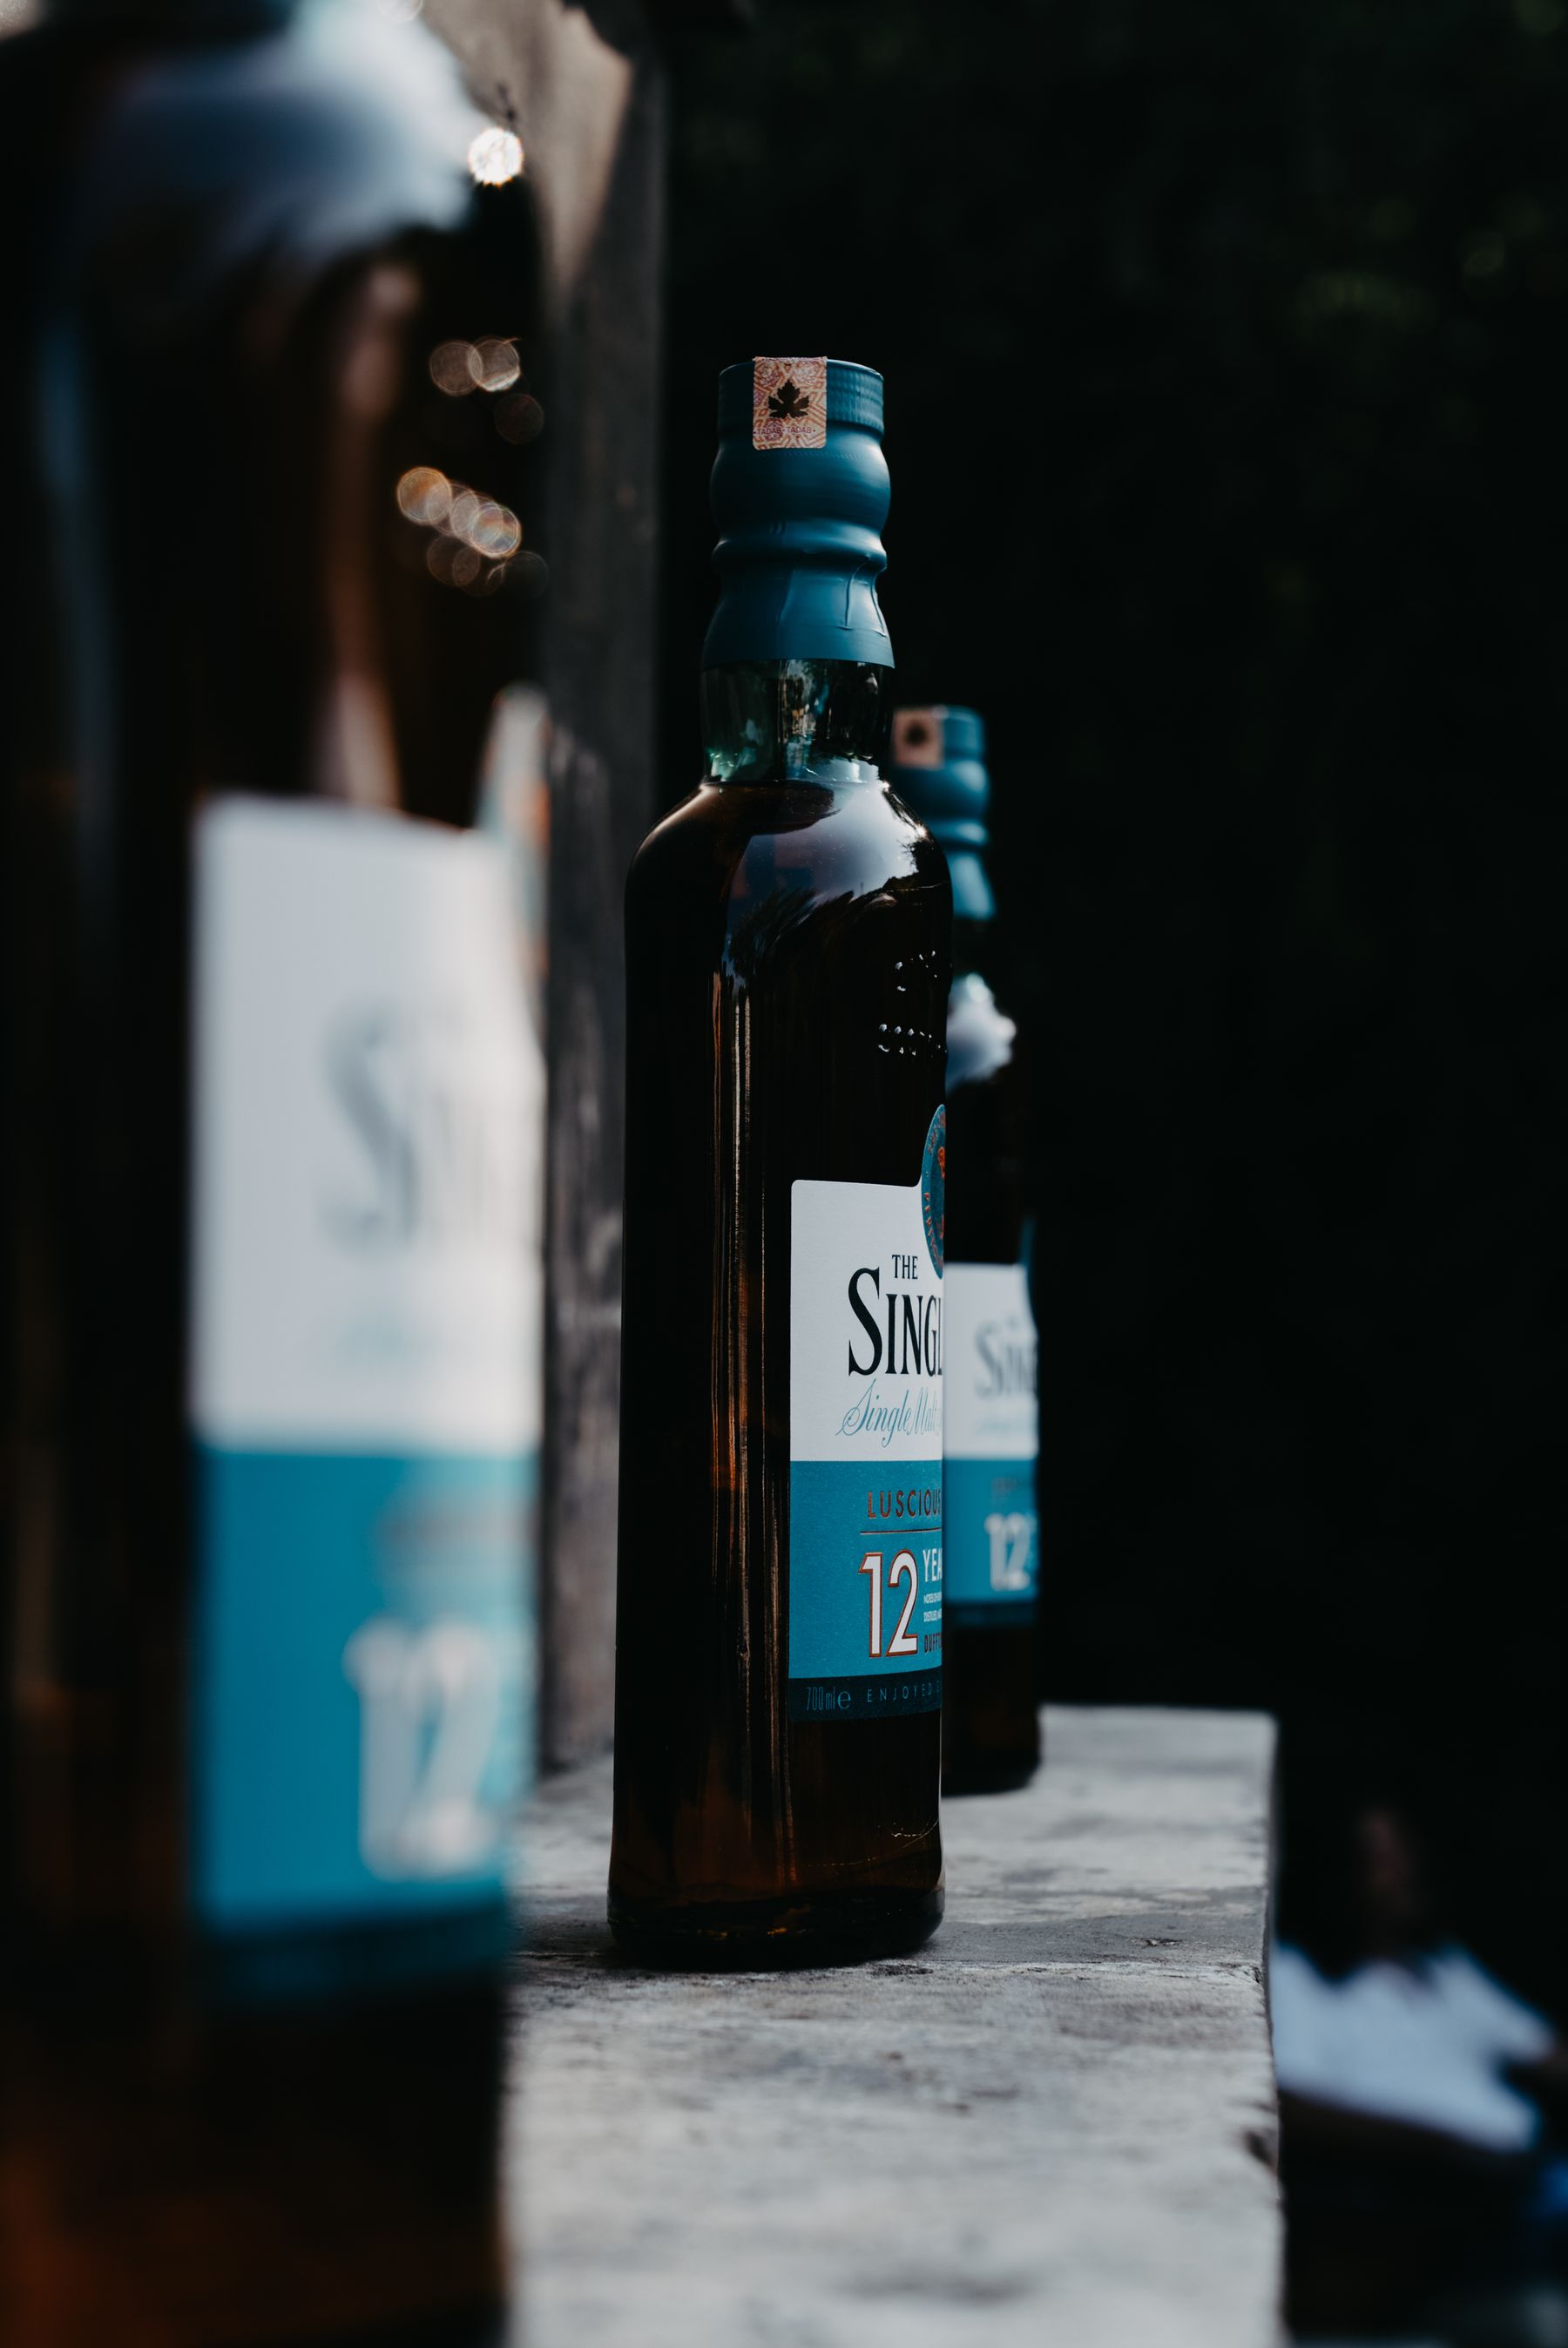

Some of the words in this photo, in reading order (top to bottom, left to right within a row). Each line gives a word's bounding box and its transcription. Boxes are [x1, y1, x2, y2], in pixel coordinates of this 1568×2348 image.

[891, 1254, 918, 1279] THE
[835, 1377, 912, 1448] Single
[983, 1512, 1030, 1593] 12
[857, 1548, 920, 1658] 12
